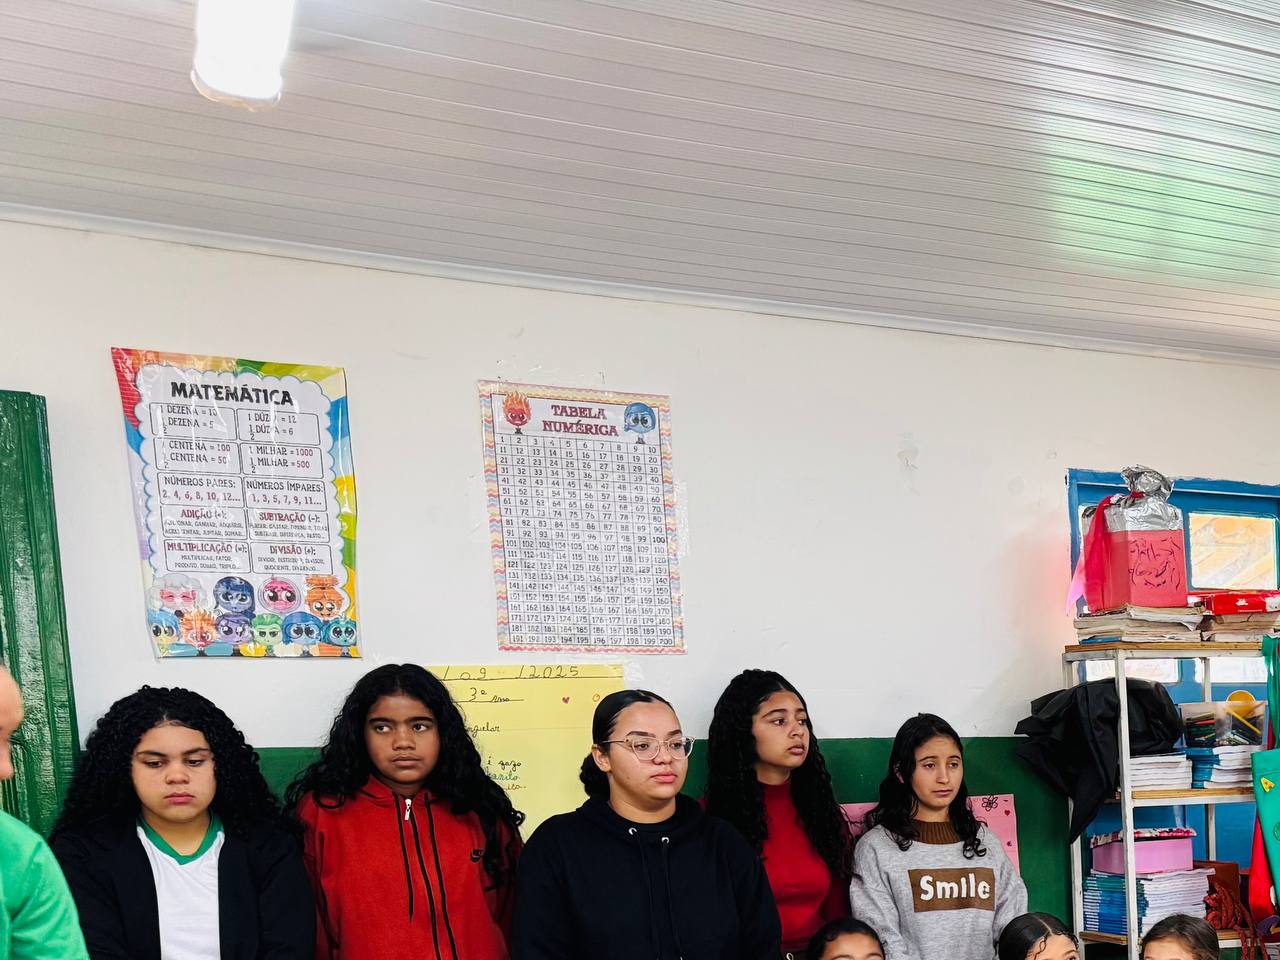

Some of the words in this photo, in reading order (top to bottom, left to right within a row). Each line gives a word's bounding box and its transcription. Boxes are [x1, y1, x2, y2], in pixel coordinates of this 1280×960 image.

[171, 382, 293, 406] MATEMÁTICA
[551, 404, 608, 420] TABELA
[542, 419, 619, 437] NUMÉRICA
[169, 440, 207, 451] CENTENA
[170, 453, 208, 463] CENTENA
[164, 475, 204, 487] NÚMEROS
[246, 480, 285, 490] NÚMEROS
[259, 512, 306, 523] SUBTRAÇÃO
[167, 542, 232, 554] MULTIPLICAÇÃO
[270, 545, 302, 555] DIVISÃO
[920, 873, 991, 901] Smile
